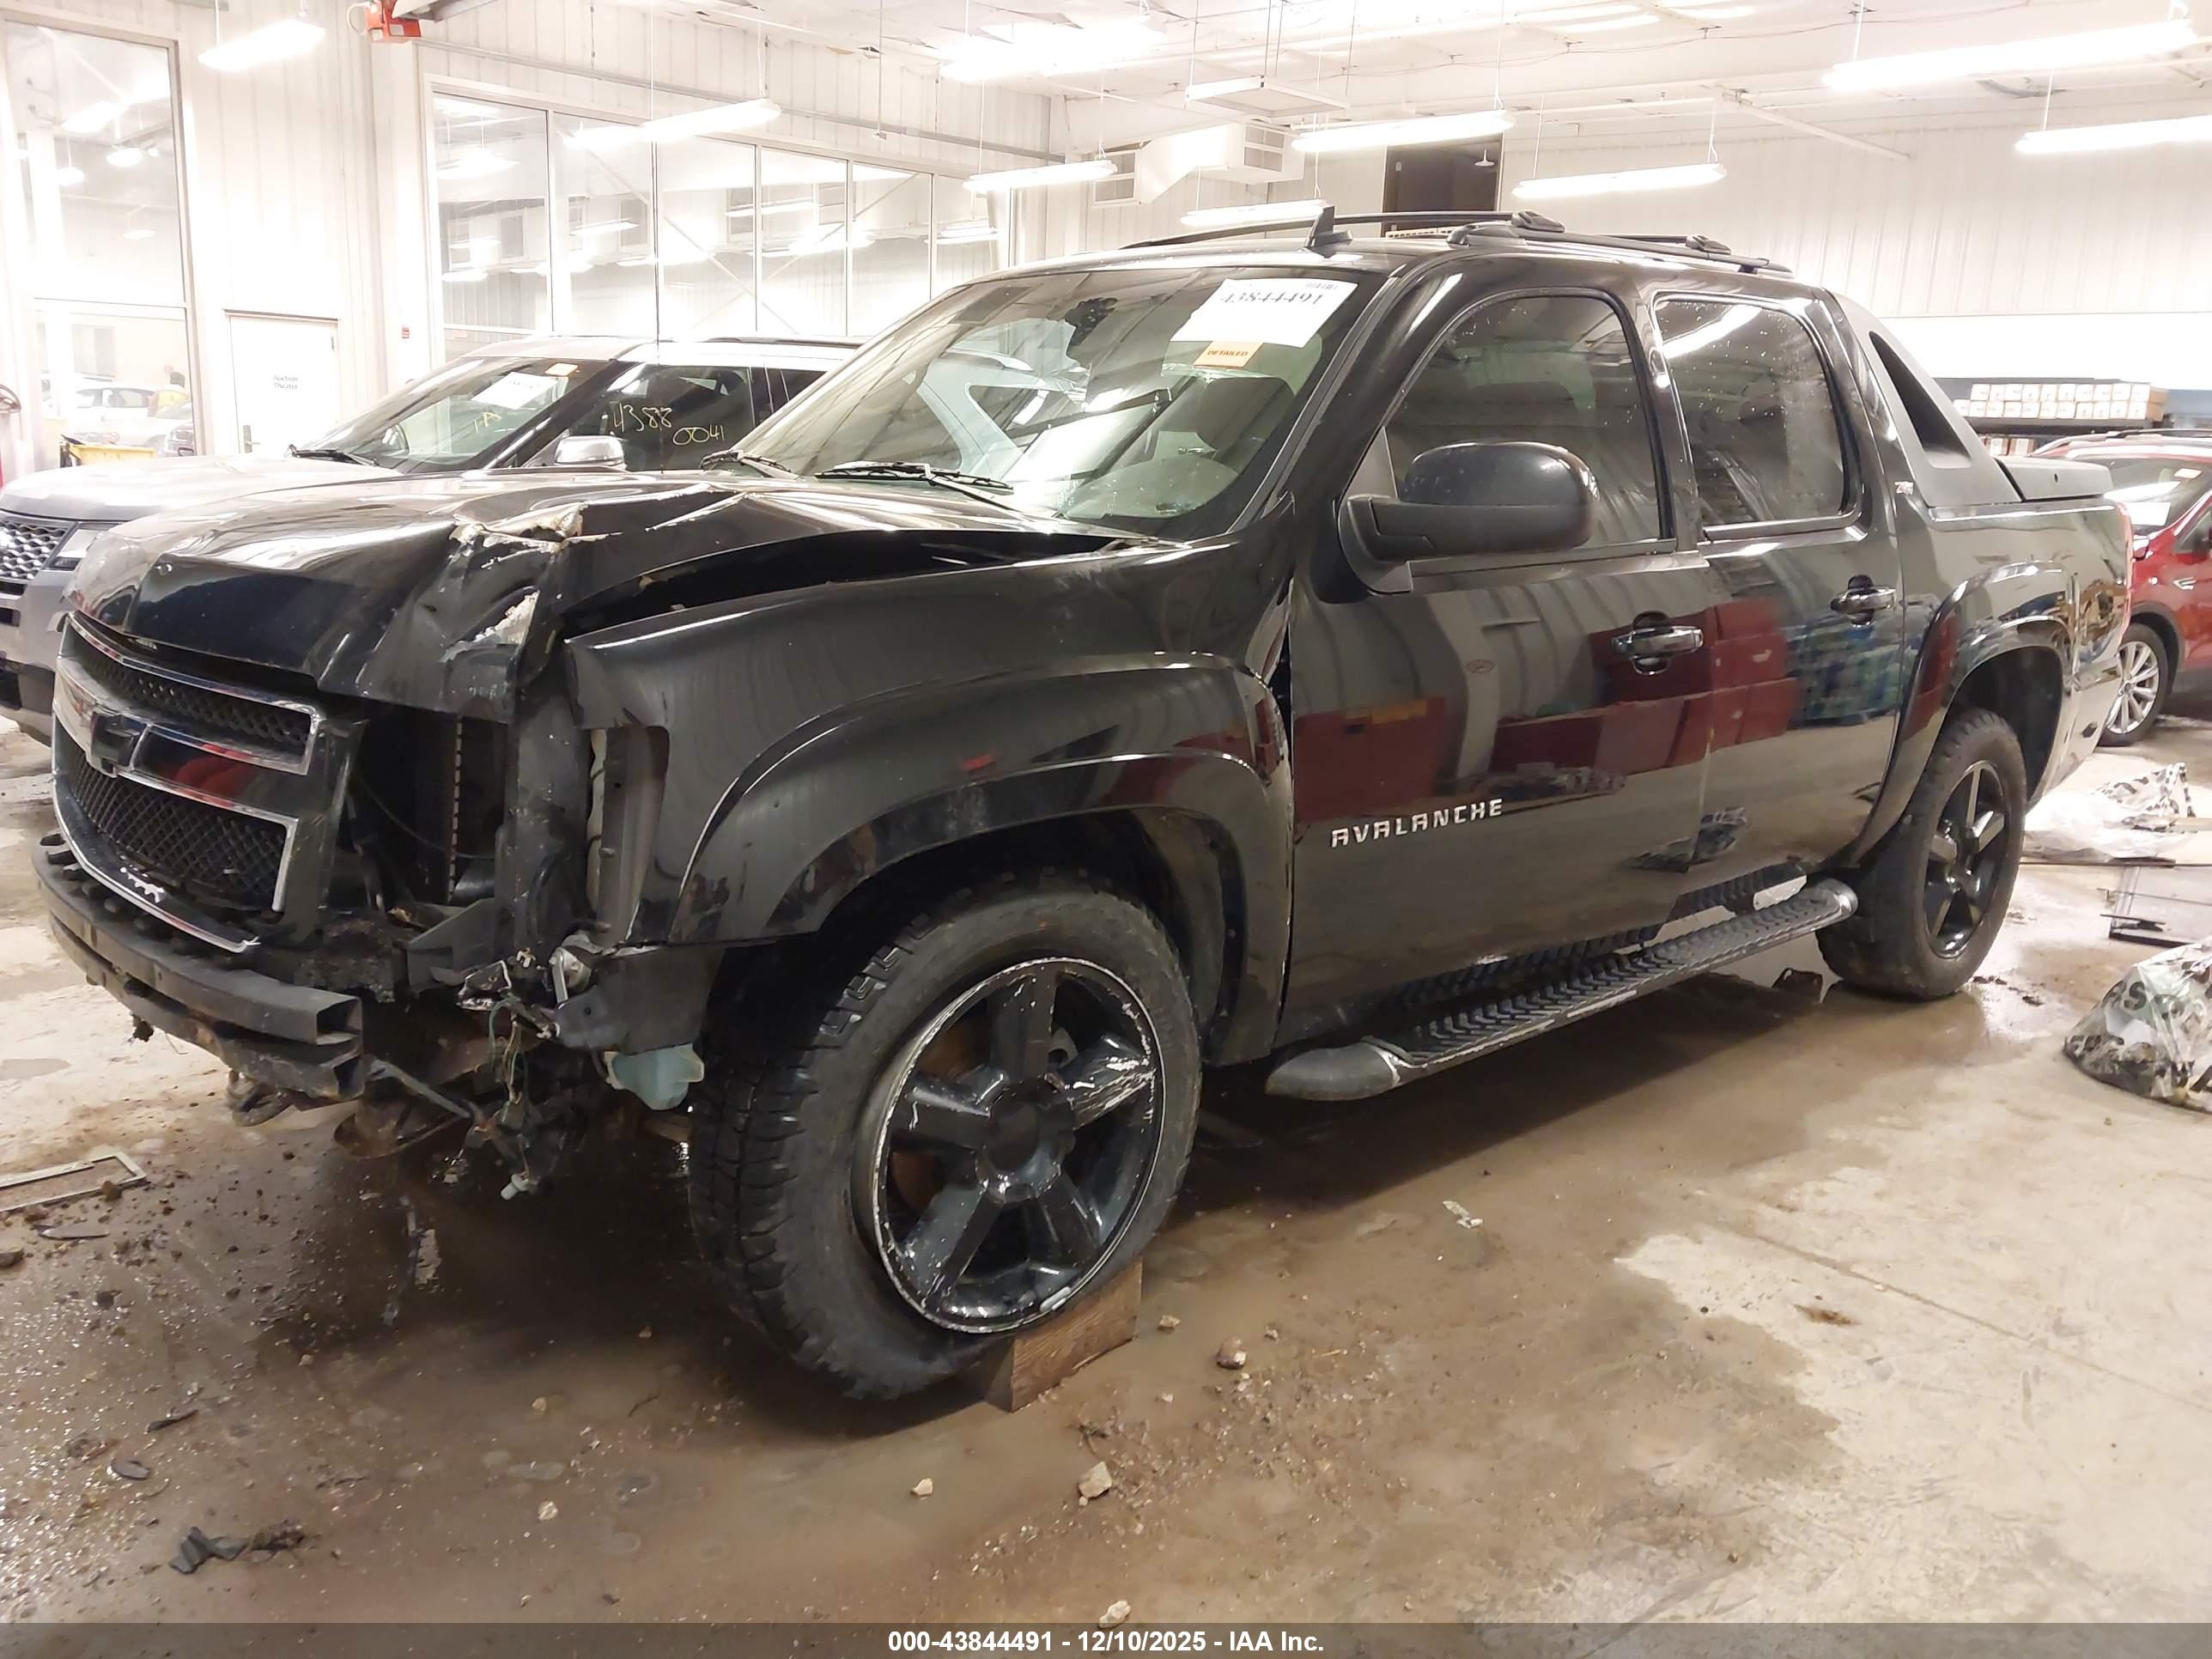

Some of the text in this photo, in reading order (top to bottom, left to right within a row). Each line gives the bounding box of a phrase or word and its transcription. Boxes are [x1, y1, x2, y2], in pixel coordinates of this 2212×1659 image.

[1206, 349, 1249, 357] DETAILED
[613, 403, 672, 433] 4388
[672, 424, 725, 445] 0041
[1331, 799, 1504, 848] AVALANCHE
